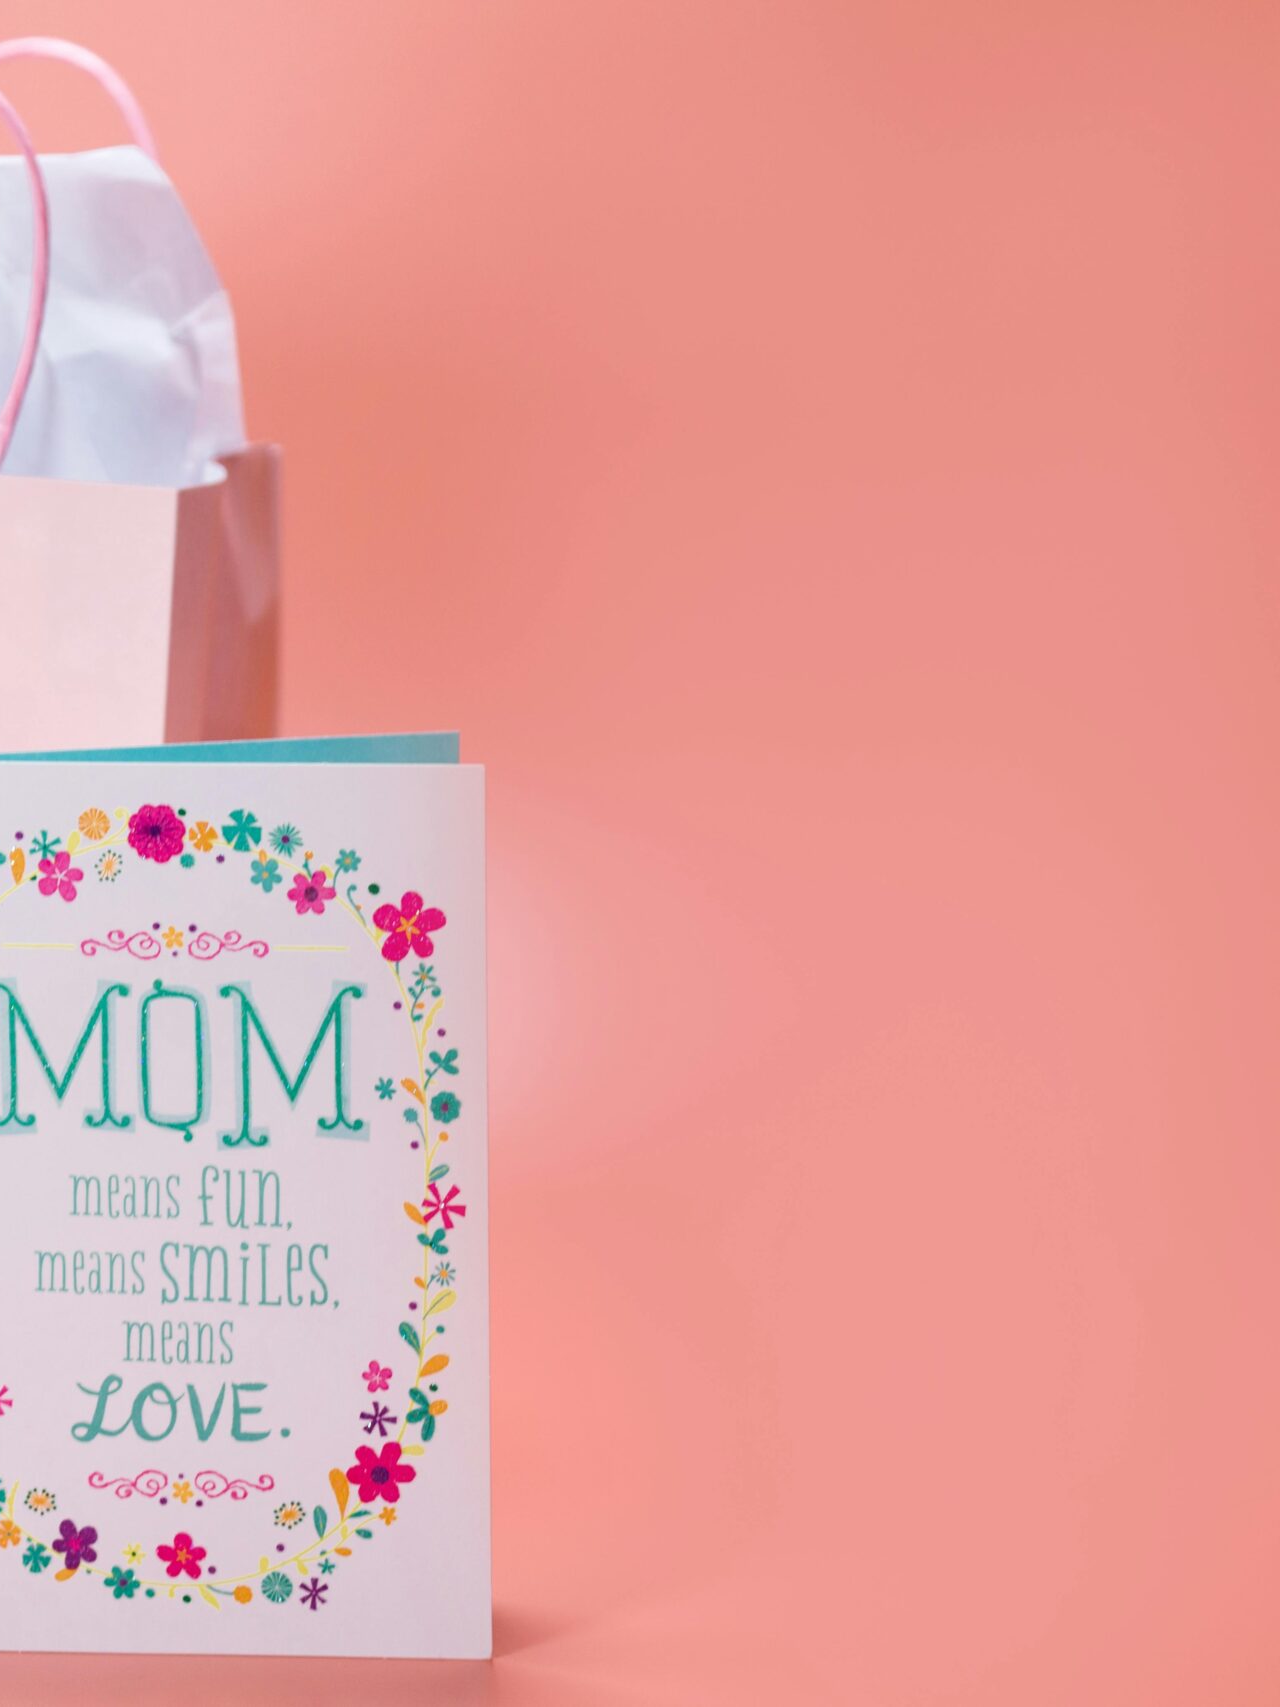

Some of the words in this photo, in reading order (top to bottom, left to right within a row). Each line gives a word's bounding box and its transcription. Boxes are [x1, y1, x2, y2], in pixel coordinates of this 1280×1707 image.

[68, 1174, 181, 1219] means
[197, 1165, 293, 1231] fun,
[34, 1250, 146, 1295] means
[122, 1320, 234, 1366] means
[71, 1374, 291, 1443] LOVE.
